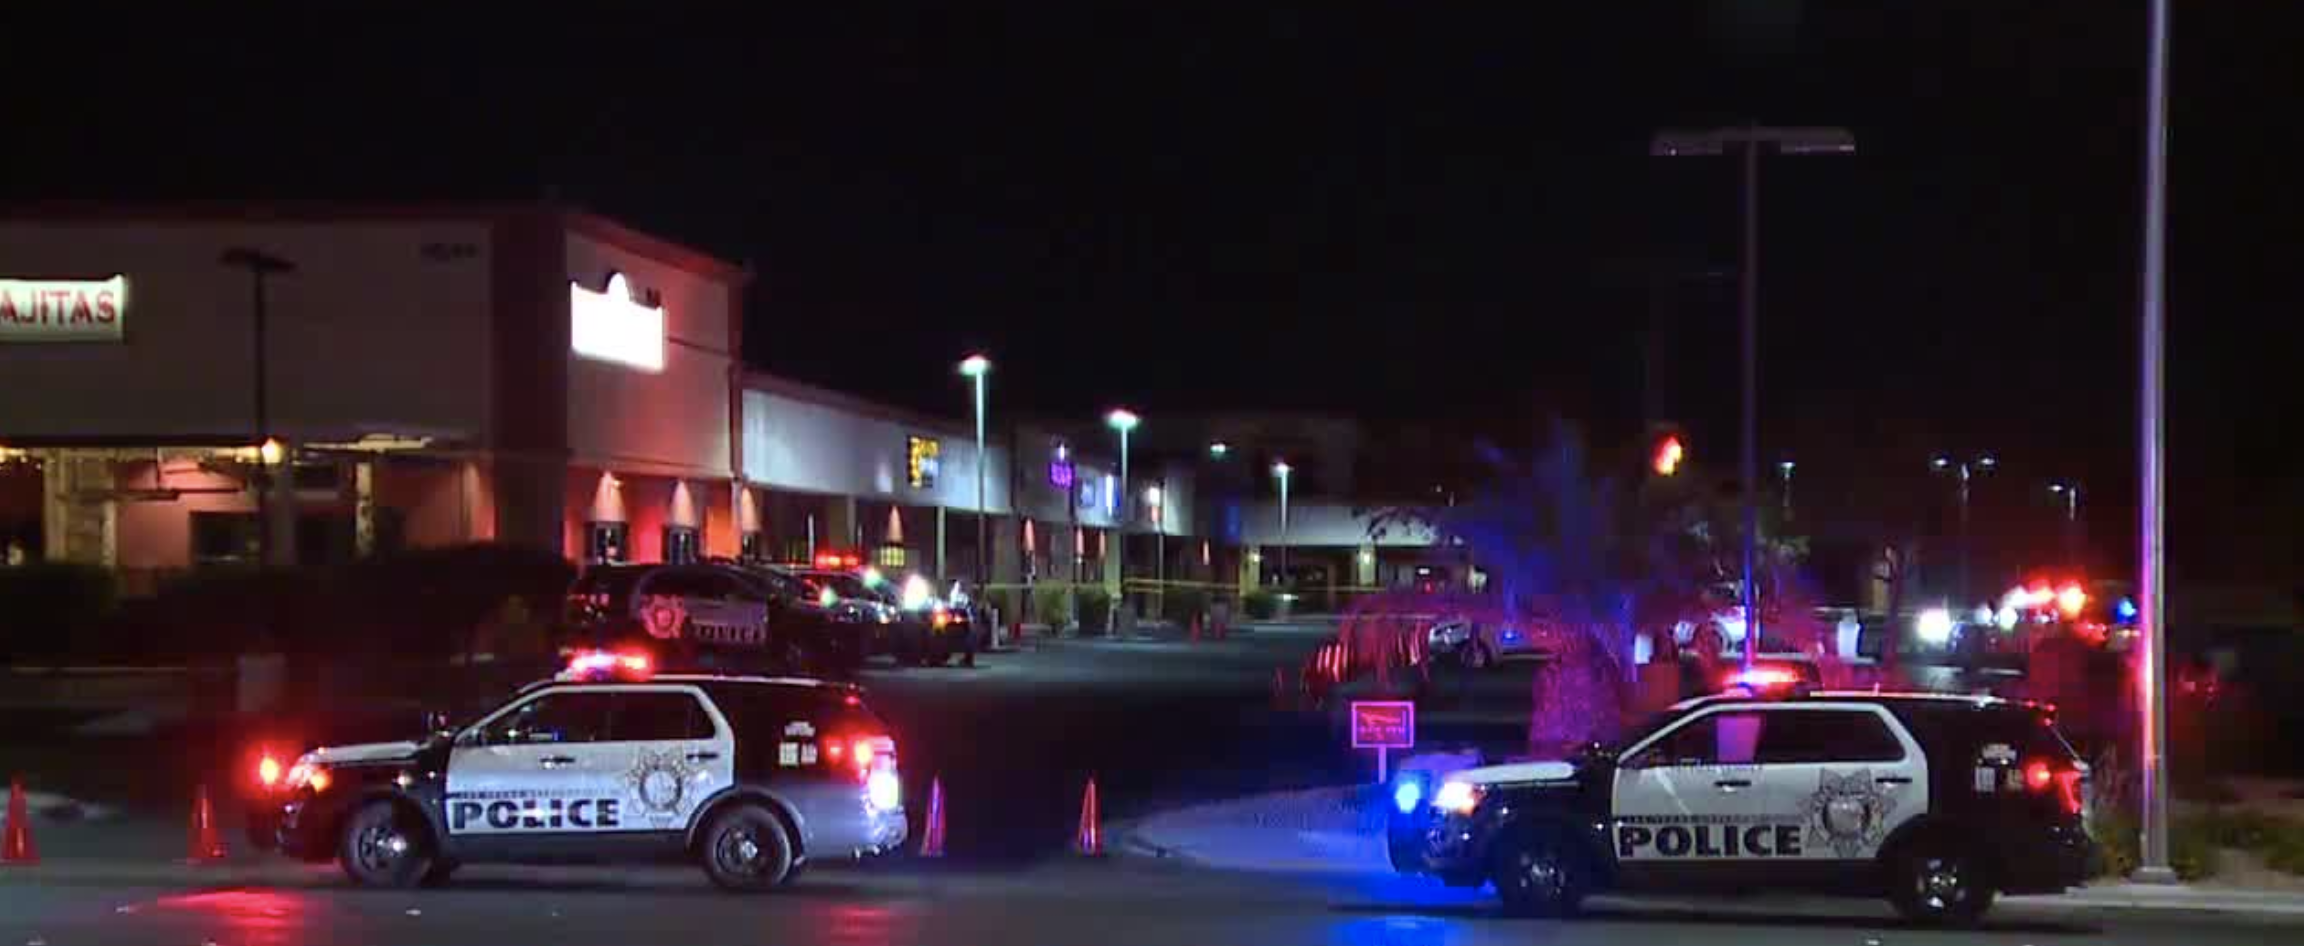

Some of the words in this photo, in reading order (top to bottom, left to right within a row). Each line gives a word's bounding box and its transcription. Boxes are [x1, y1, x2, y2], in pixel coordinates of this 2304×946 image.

[0, 290, 116, 324] AJITAS
[452, 799, 620, 830] POLICE
[1618, 824, 1802, 857] POLICE
